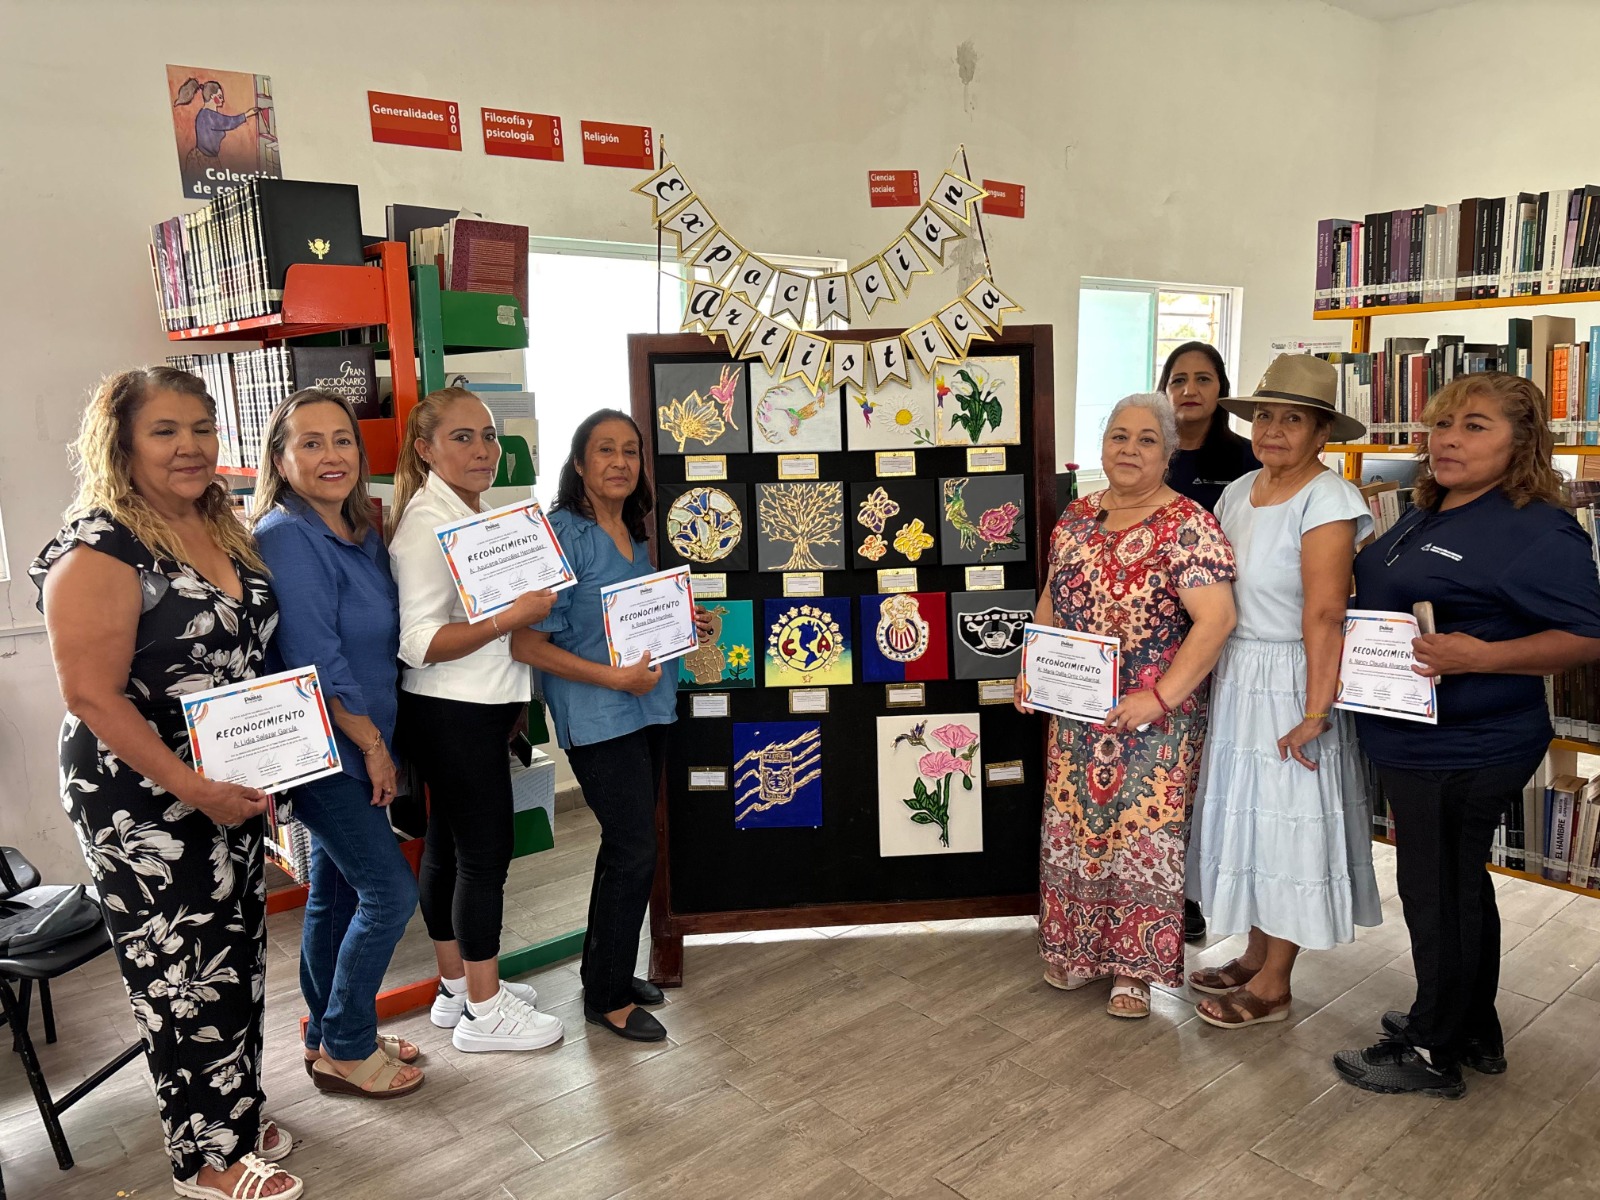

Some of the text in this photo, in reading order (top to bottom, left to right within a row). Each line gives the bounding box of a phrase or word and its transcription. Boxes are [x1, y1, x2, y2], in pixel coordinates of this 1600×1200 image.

[372, 104, 444, 121] Generalidades
[484, 112, 533, 128] Filosofía y
[486, 128, 535, 142] psicología
[583, 131, 620, 144] Religión
[870, 173, 896, 182] Ciencias
[193, 181, 211, 194] de
[871, 184, 896, 193] sociales
[984, 188, 1006, 198] enguas
[690, 289, 1000, 371] Artistica
[339, 360, 366, 379] GRAN
[314, 376, 367, 387] DICCIONARIO
[467, 533, 538, 563] RECONOCIMIENTO
[619, 600, 680, 622] RECONOCIMIENTO
[782, 633, 831, 657] C A
[1352, 646, 1415, 660] RECONOCIMIENT
[1036, 656, 1101, 675] RECONOCIMIENTO
[216, 709, 305, 740] RECONOCIMIENTO
[240, 736, 256, 747] Lidia
[255, 731, 276, 742] Salazar
[277, 725, 298, 737] García
[1554, 818, 1567, 860] EL HAMBRE
